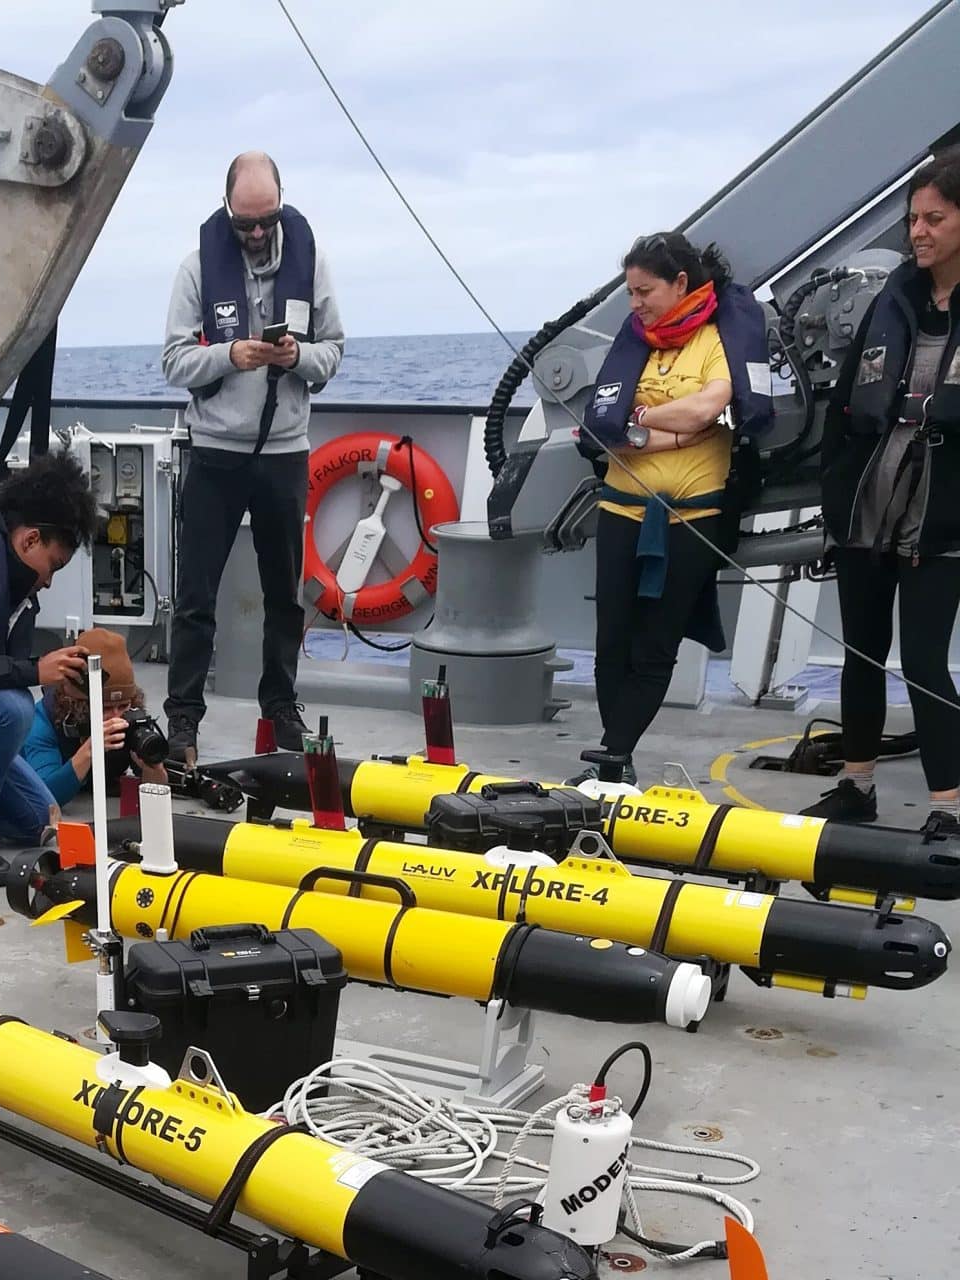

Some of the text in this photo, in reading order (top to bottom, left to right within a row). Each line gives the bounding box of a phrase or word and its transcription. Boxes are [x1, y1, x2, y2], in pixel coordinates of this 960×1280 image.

[314, 448, 372, 482] FALKOR
[615, 804, 690, 828] ORE-3
[402, 862, 456, 878] LAUV
[470, 870, 609, 906] XPLORE-4
[72, 1079, 207, 1152] XORE-5
